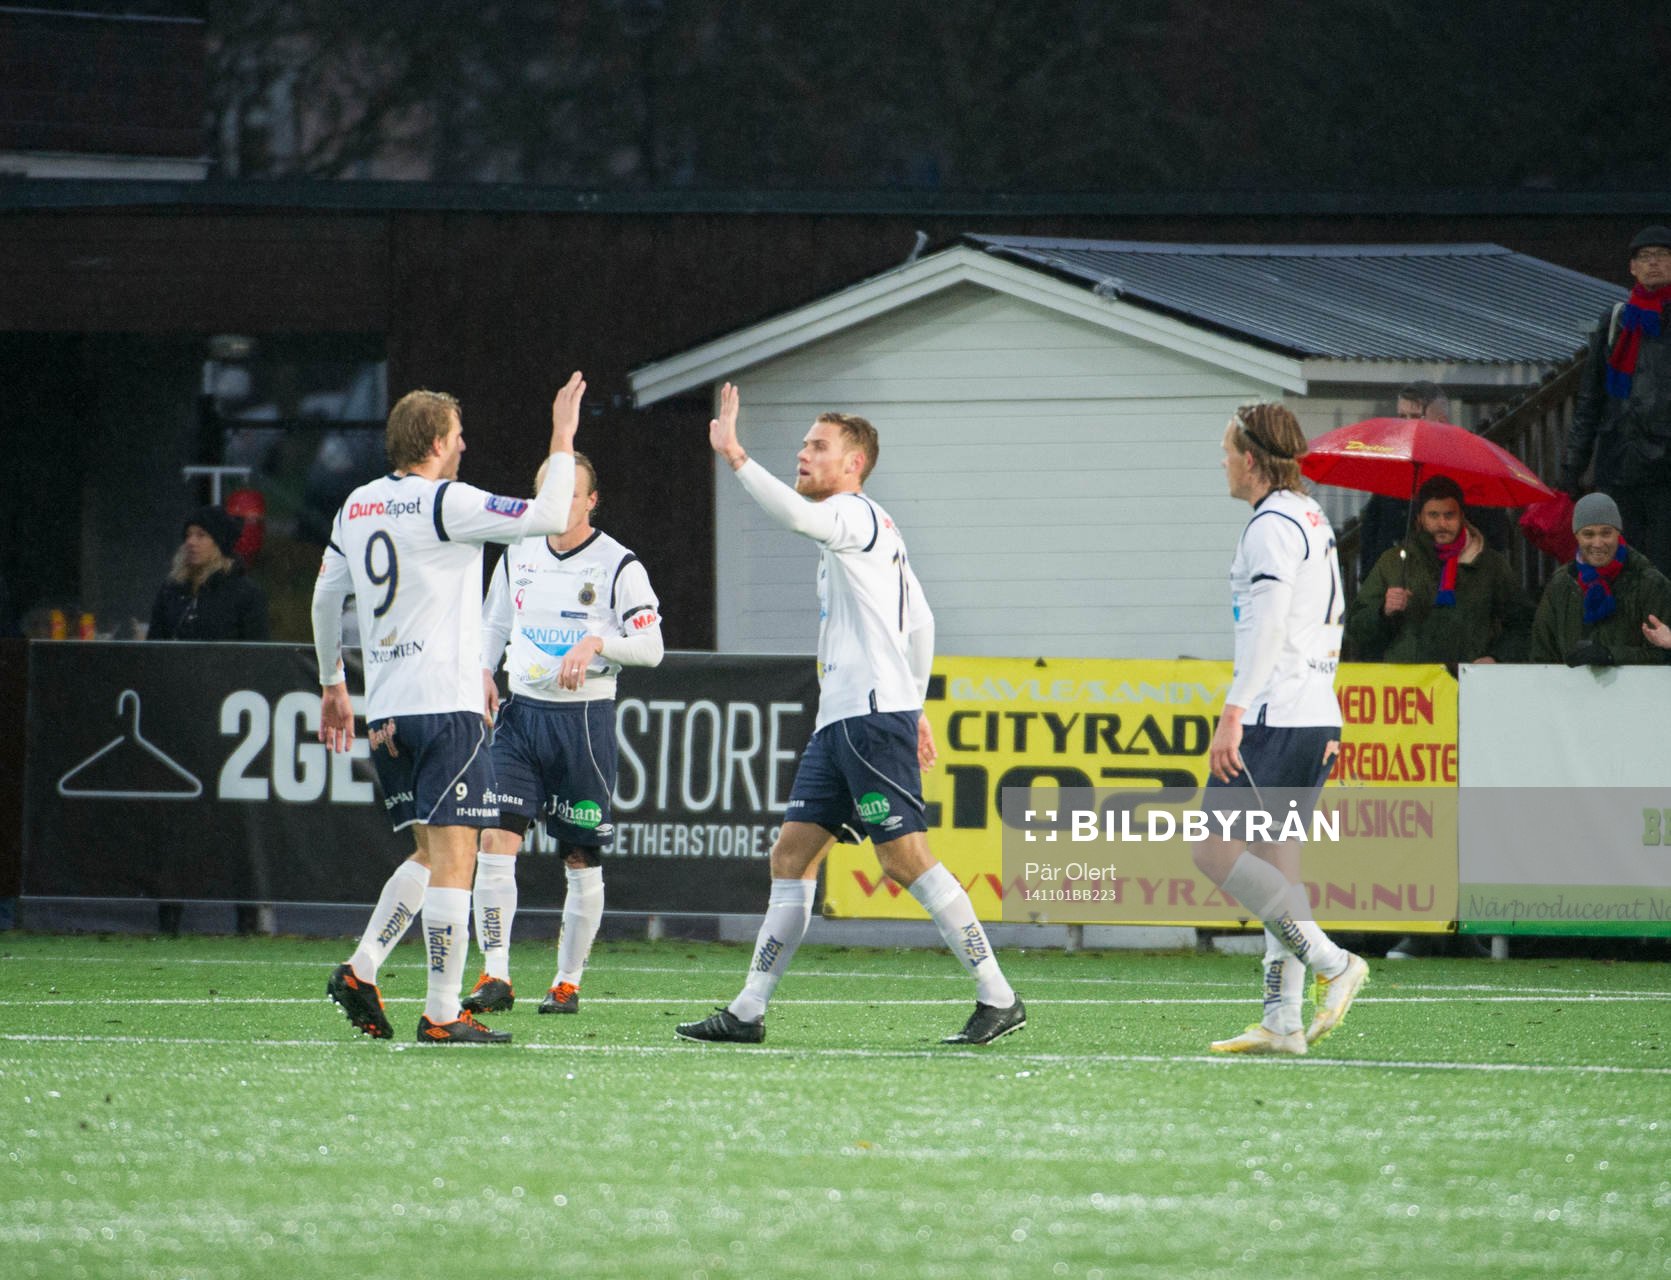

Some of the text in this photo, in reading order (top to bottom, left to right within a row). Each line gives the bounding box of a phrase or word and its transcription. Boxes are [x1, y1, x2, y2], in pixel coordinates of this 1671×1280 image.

[364, 530, 399, 619] 9
[1383, 686, 1434, 726] DEN
[454, 782, 468, 801] 9
[548, 794, 603, 821] Johans
[484, 906, 502, 952] Tvättex
[1468, 896, 1647, 928] Närproducerat
[427, 925, 452, 974] Tvättex
